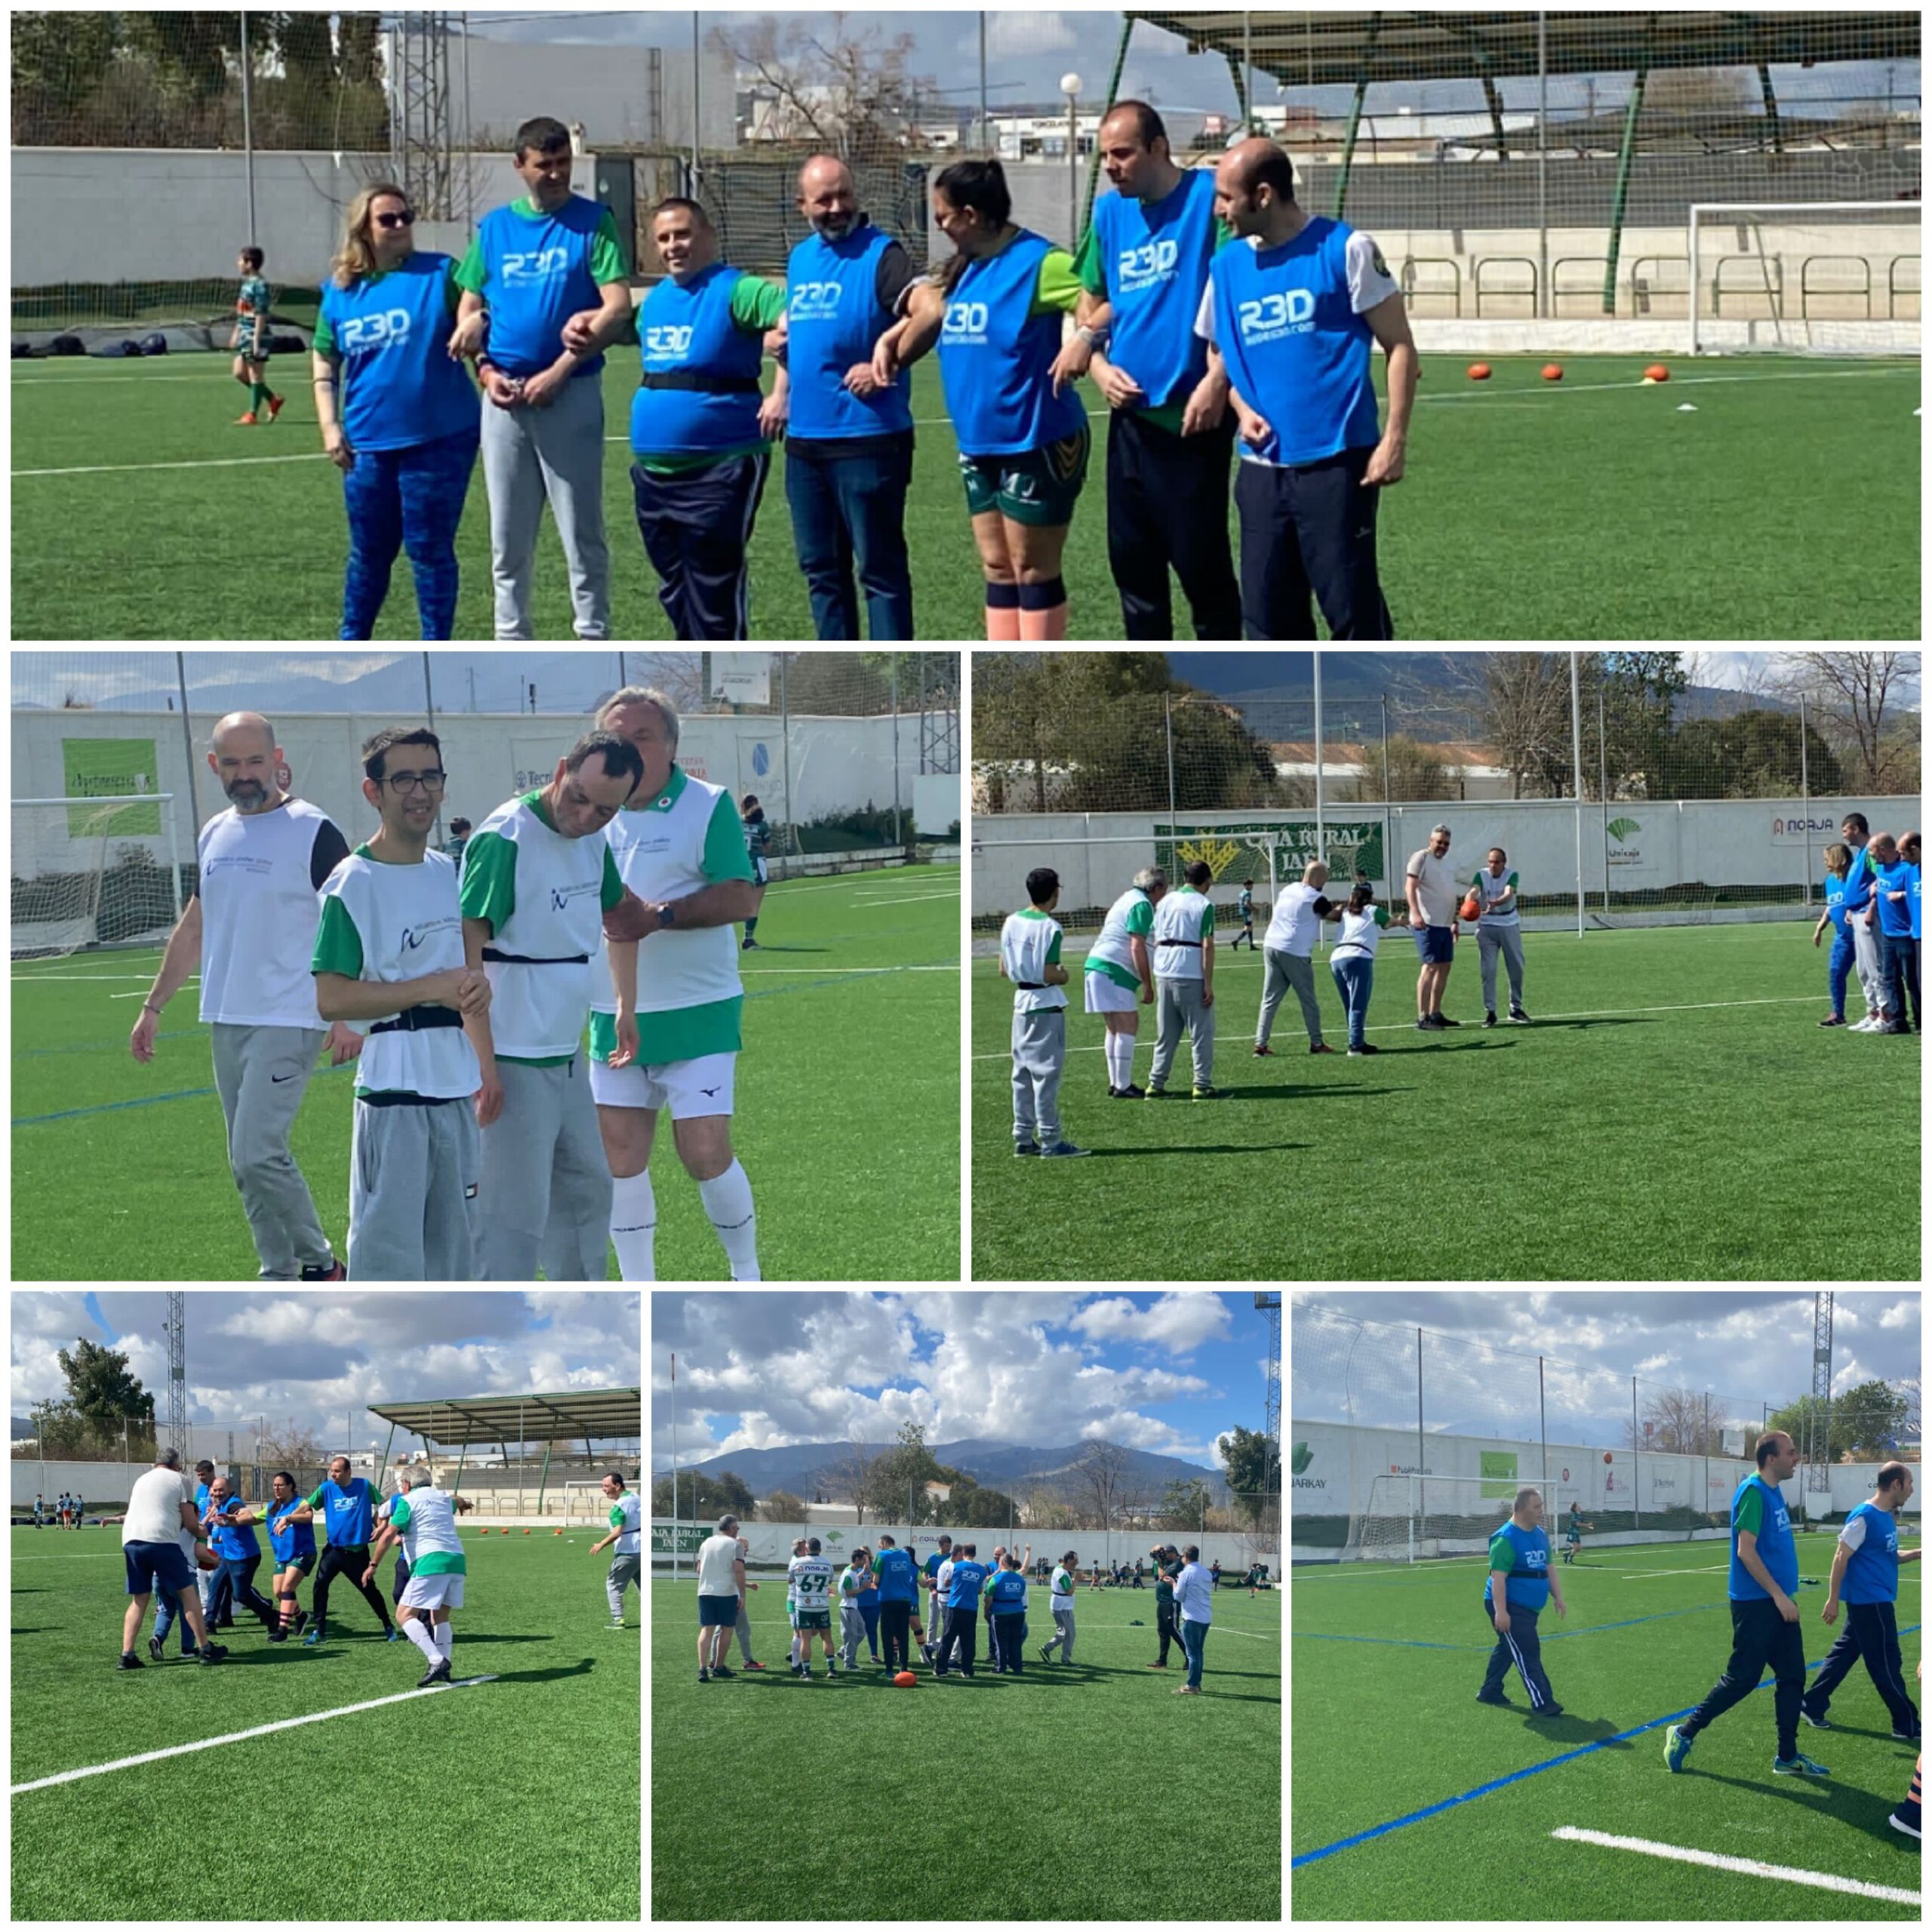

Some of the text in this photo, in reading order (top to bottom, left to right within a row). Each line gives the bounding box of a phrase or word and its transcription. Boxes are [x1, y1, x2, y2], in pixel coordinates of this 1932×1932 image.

[1238, 288, 1315, 334] R3D
[1787, 819, 1833, 831] NOAJA
[800, 1574, 827, 1593] 67
